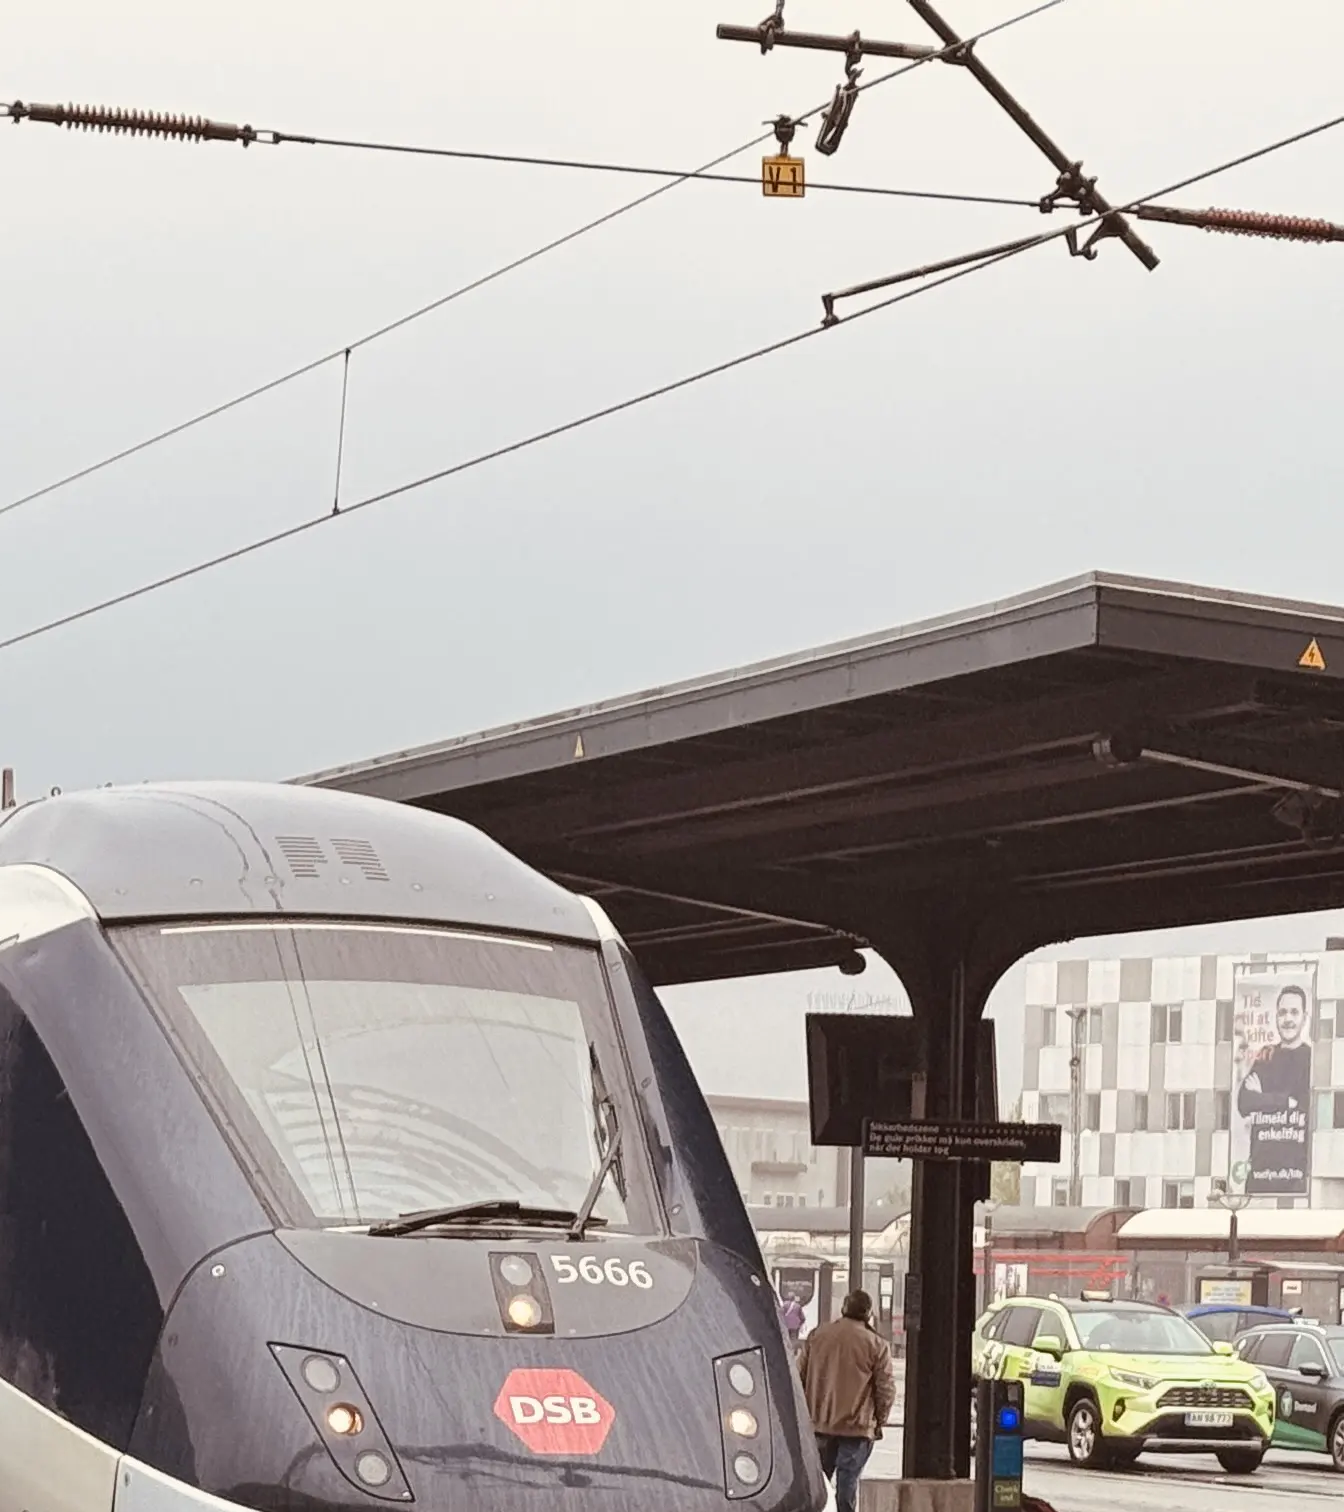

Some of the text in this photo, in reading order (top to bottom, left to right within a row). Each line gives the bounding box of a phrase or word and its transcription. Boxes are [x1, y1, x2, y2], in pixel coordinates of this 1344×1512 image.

[1289, 1111, 1306, 1127] dig
[550, 1255, 654, 1289] 5666
[509, 1395, 602, 1425] DSB
